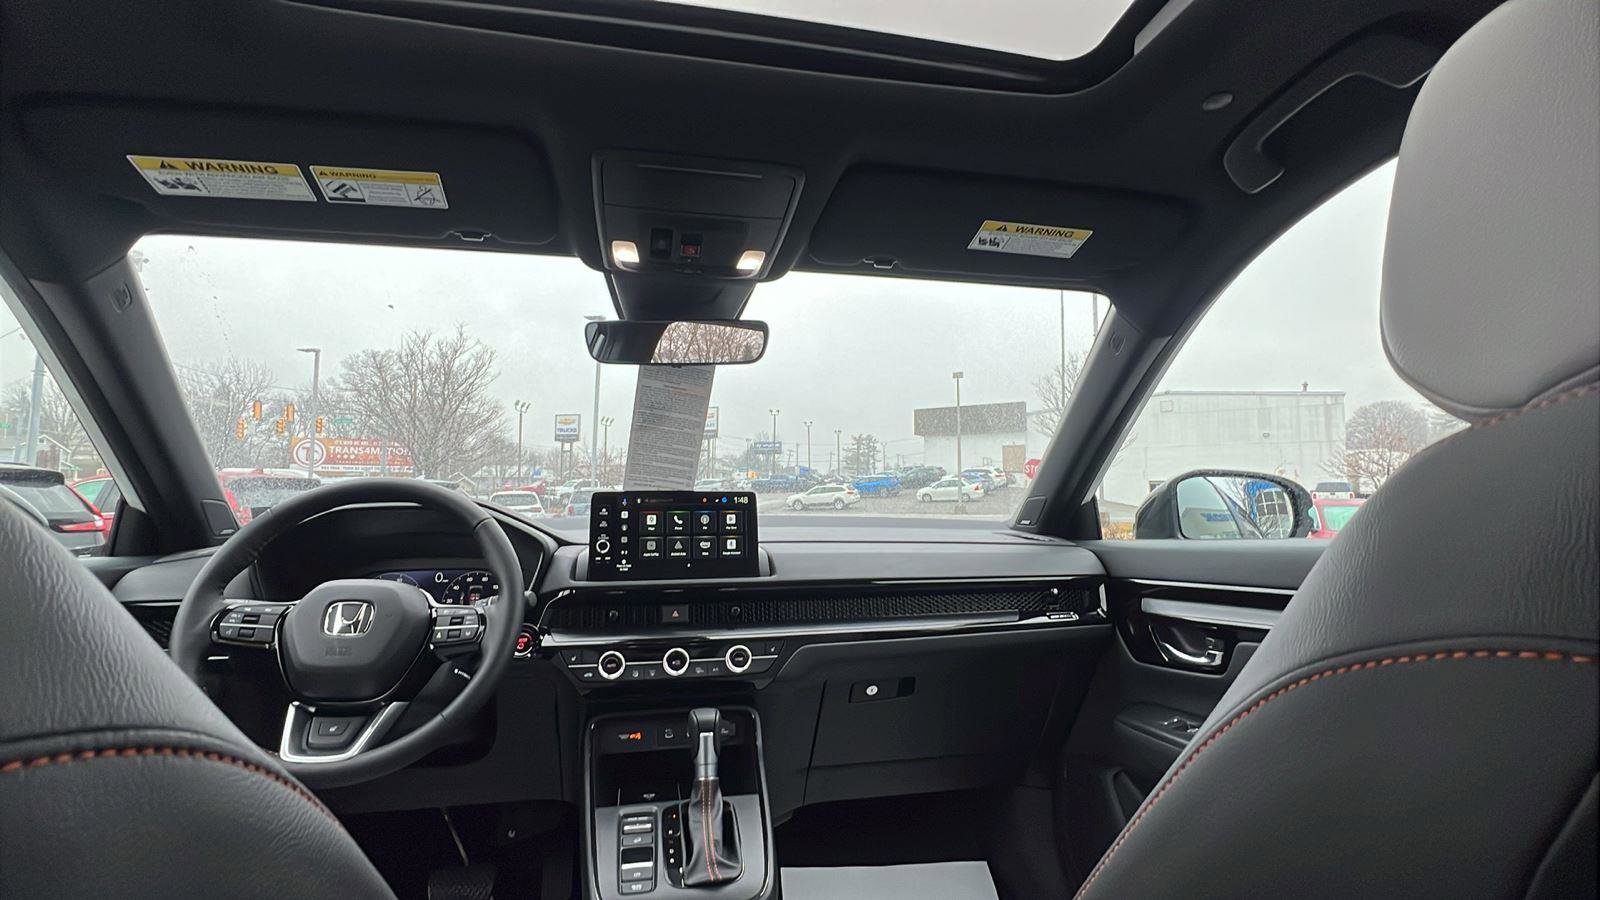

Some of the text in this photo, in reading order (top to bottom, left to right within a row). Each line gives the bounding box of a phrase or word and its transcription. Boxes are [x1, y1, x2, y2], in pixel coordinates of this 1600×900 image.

[185, 161, 278, 175] WARNING
[330, 170, 377, 179] WARNING
[1015, 225, 1075, 238] WARNING
[733, 496, 749, 504] 1:48
